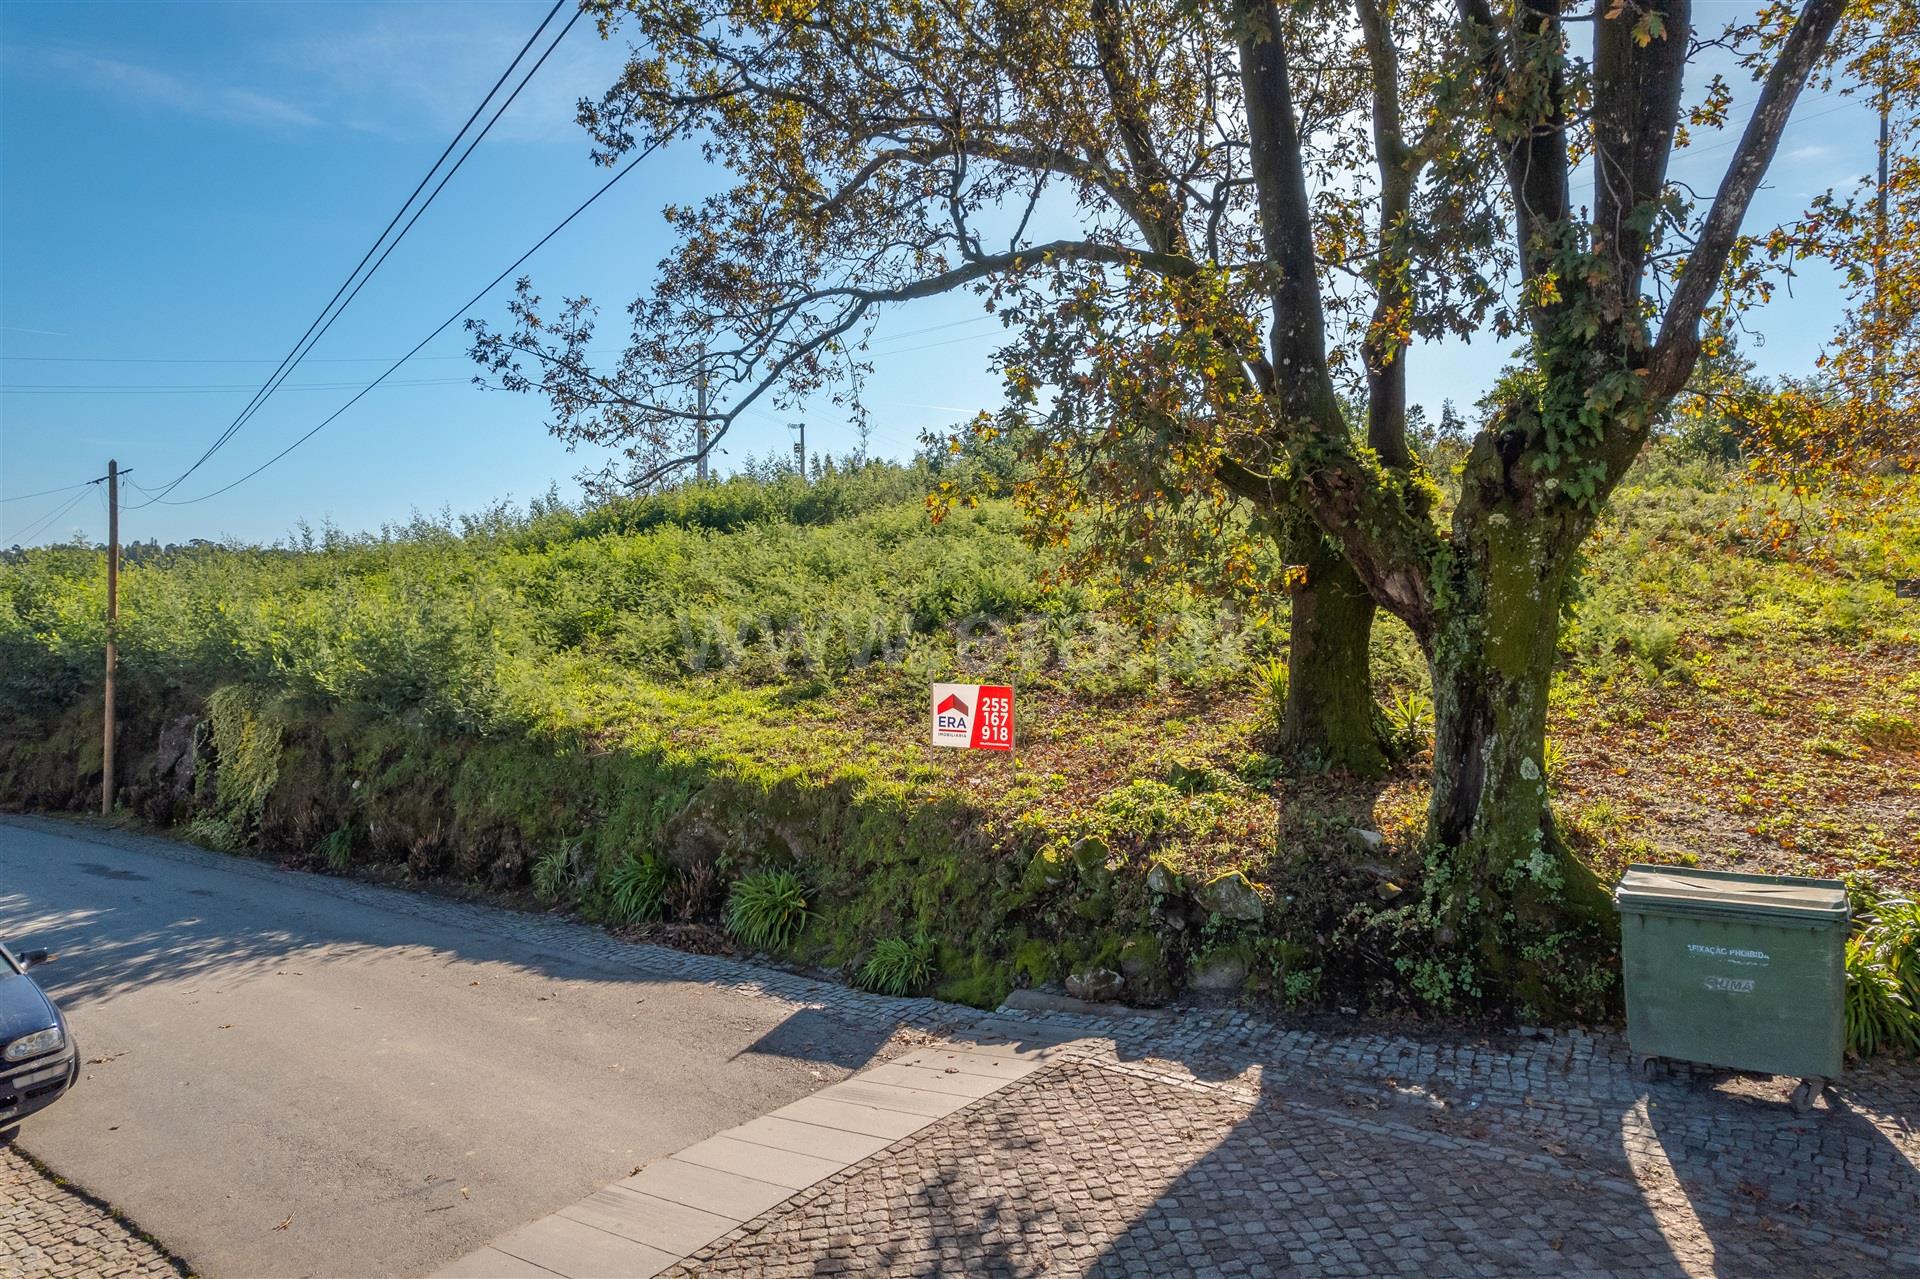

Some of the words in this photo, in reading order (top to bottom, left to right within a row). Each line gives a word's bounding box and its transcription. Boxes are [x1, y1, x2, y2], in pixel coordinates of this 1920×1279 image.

[982, 698, 1008, 711] 255
[939, 716, 966, 728] ERA
[984, 712, 1008, 726] 167
[982, 727, 1008, 740] 918
